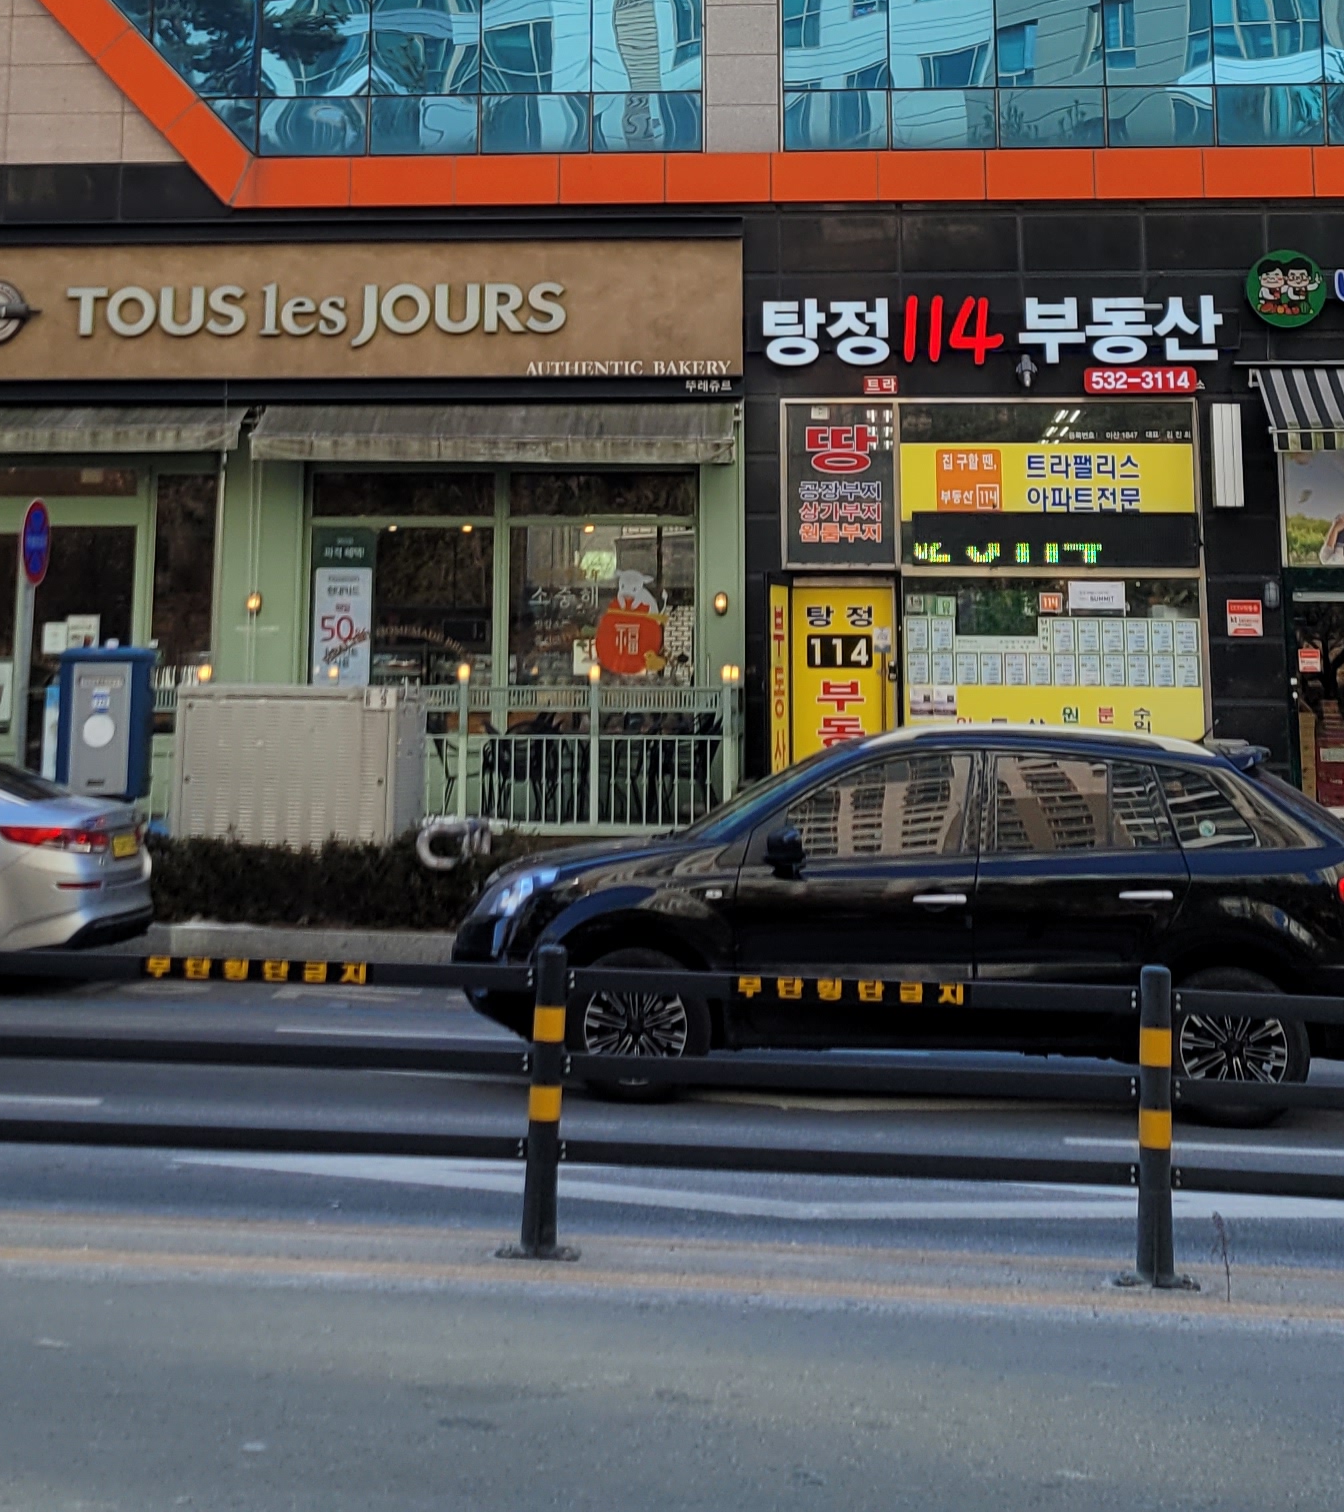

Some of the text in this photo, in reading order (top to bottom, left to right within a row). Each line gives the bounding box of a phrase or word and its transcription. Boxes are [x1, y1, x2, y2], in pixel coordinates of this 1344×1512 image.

[67, 281, 568, 347] TOUS les JOURS
[761, 294, 1225, 367] 탕정 114 부동산
[525, 359, 732, 377] AUTHENTIC BAKERY
[685, 379, 733, 393] 뚜레쥬르
[1090, 370, 1192, 391] 532-3114
[805, 424, 879, 474] 땅
[942, 453, 953, 471] 집
[956, 453, 979, 471] 구할
[1026, 454, 1141, 480] 트라팰리스
[799, 481, 882, 501] 공장부지
[941, 489, 997, 506] 부동산 114
[1026, 486, 1141, 513] 아파트전문
[799, 501, 882, 522] 상가부지
[799, 522, 882, 543] 원룸부지
[806, 604, 874, 628] 탕정
[614, 623, 640, 655] 福
[810, 637, 870, 666] 114
[737, 974, 965, 1006] 무단횡단금지
